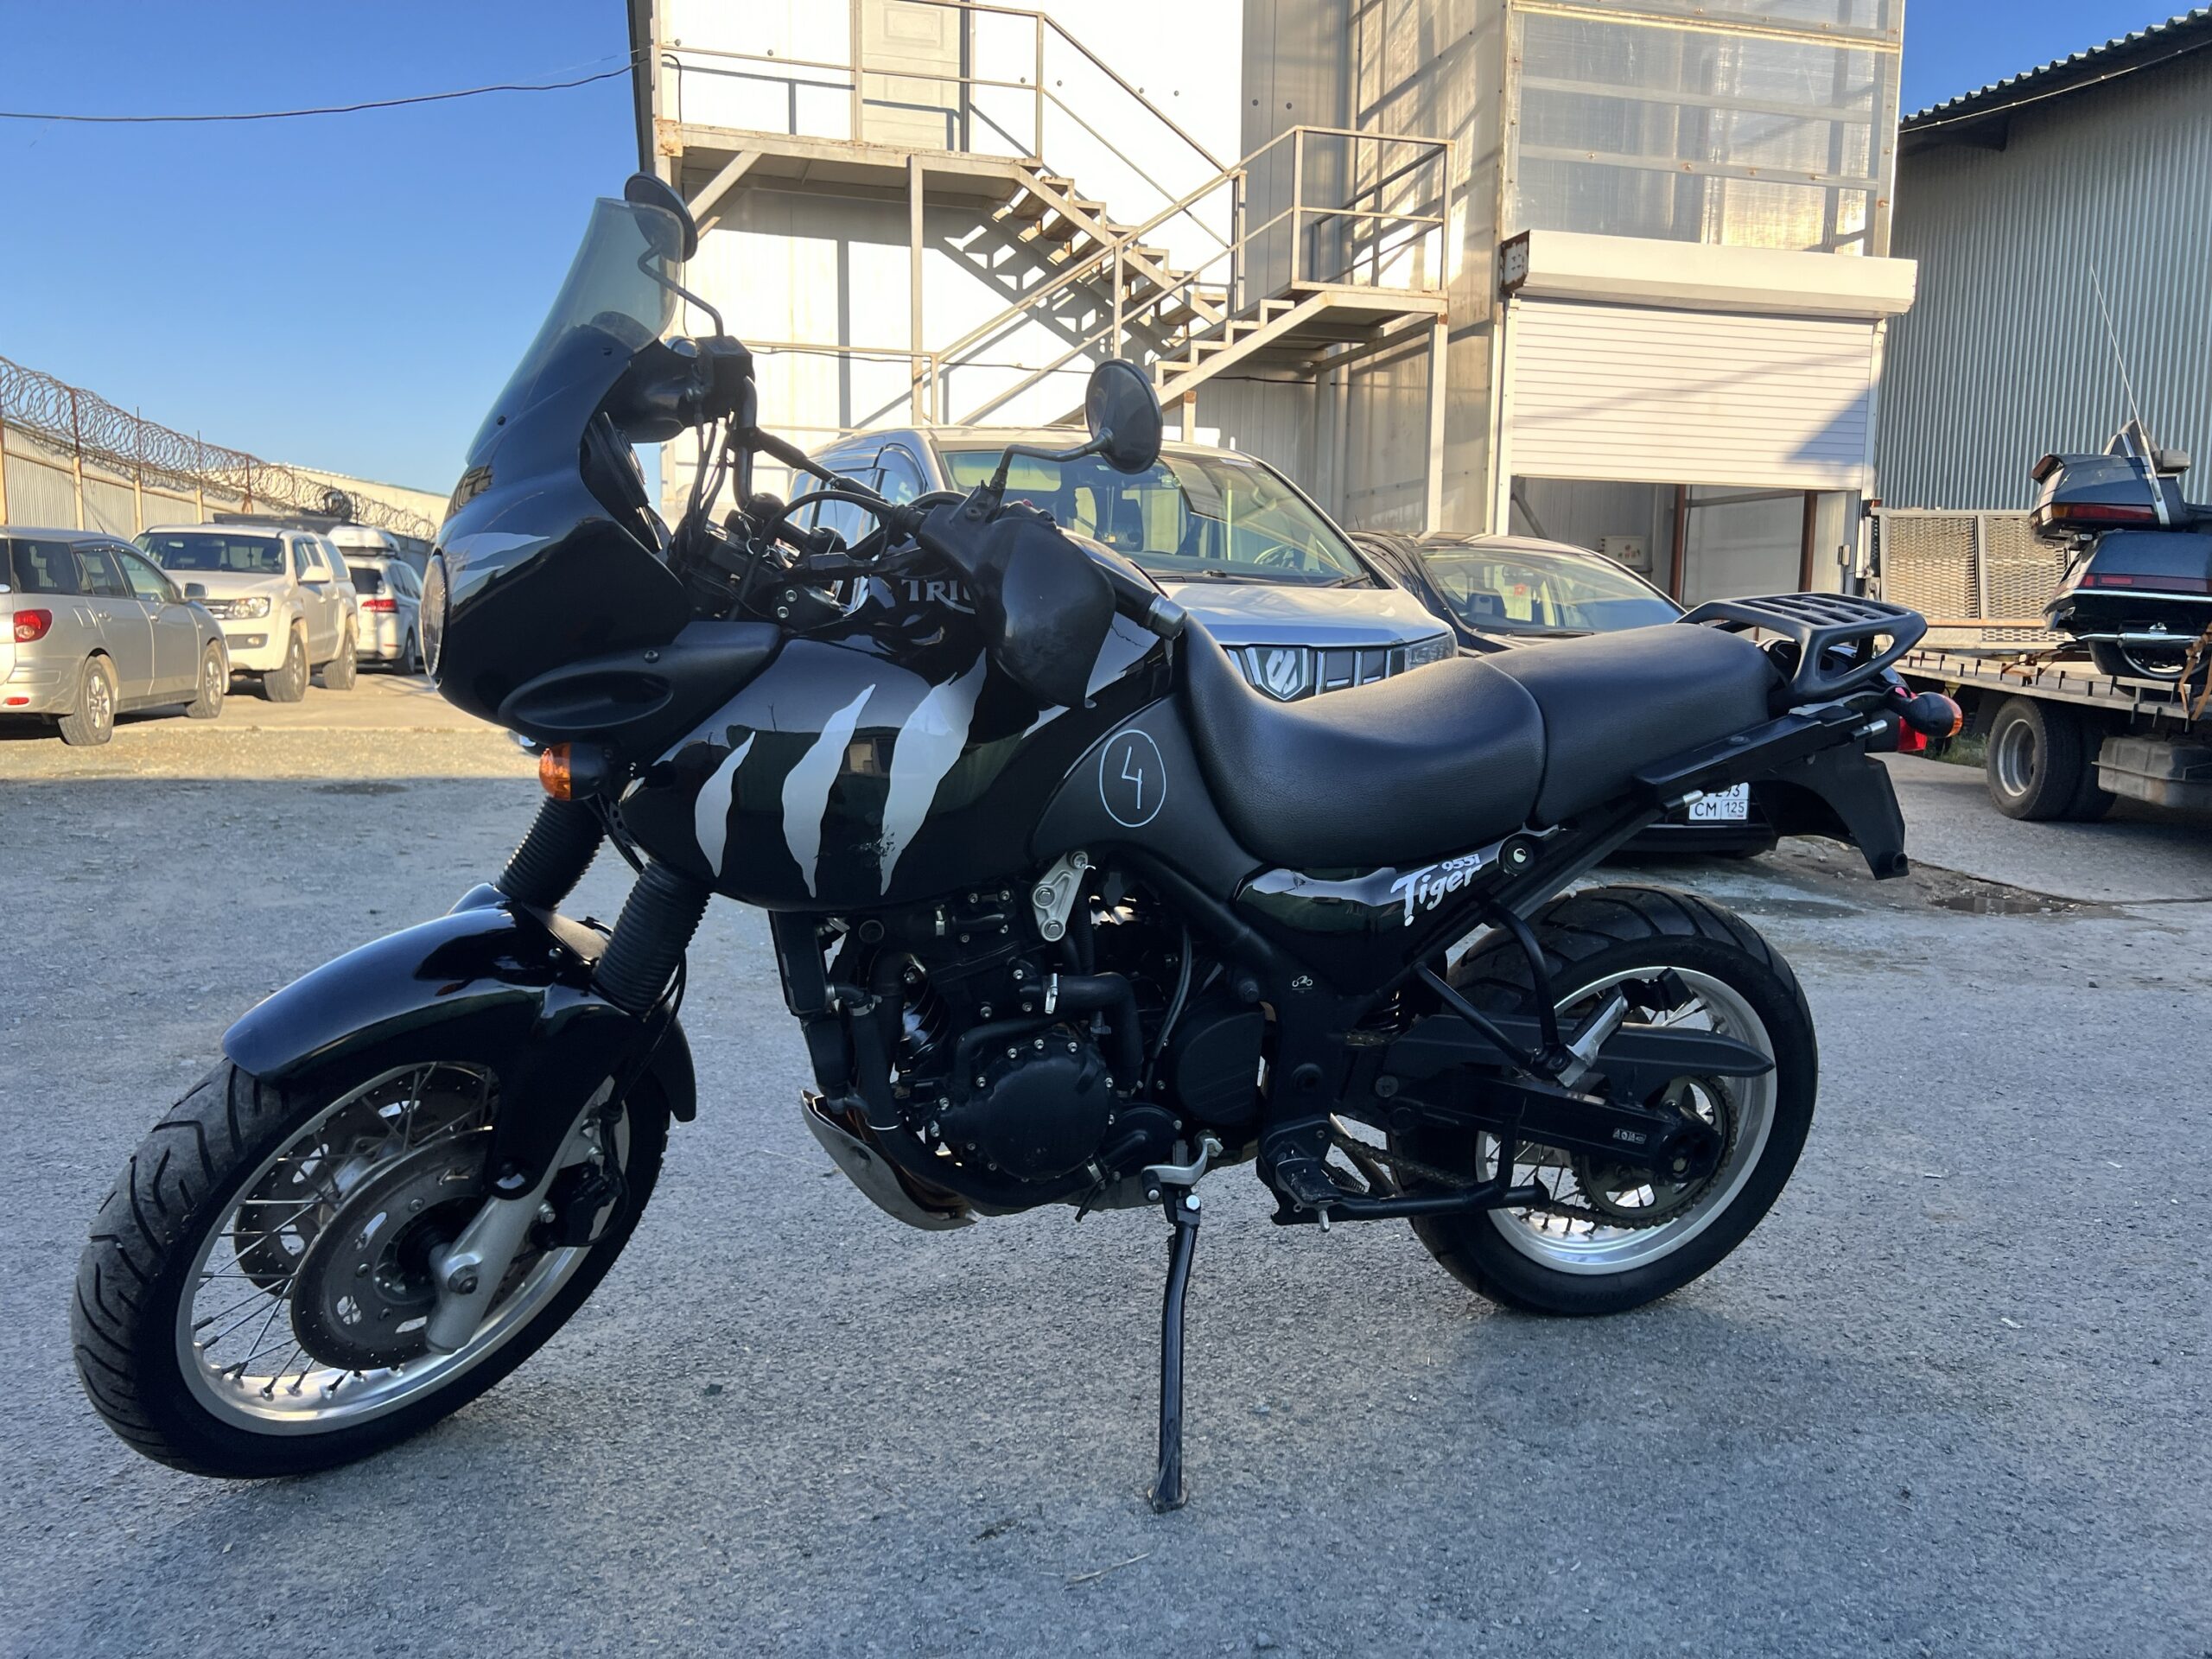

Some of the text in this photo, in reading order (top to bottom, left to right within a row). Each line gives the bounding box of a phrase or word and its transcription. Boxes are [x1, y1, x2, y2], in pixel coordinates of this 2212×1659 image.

[1121, 746, 1143, 810] 4
[1725, 802, 1745, 813] 125
[1389, 864, 1484, 927] Tiger
